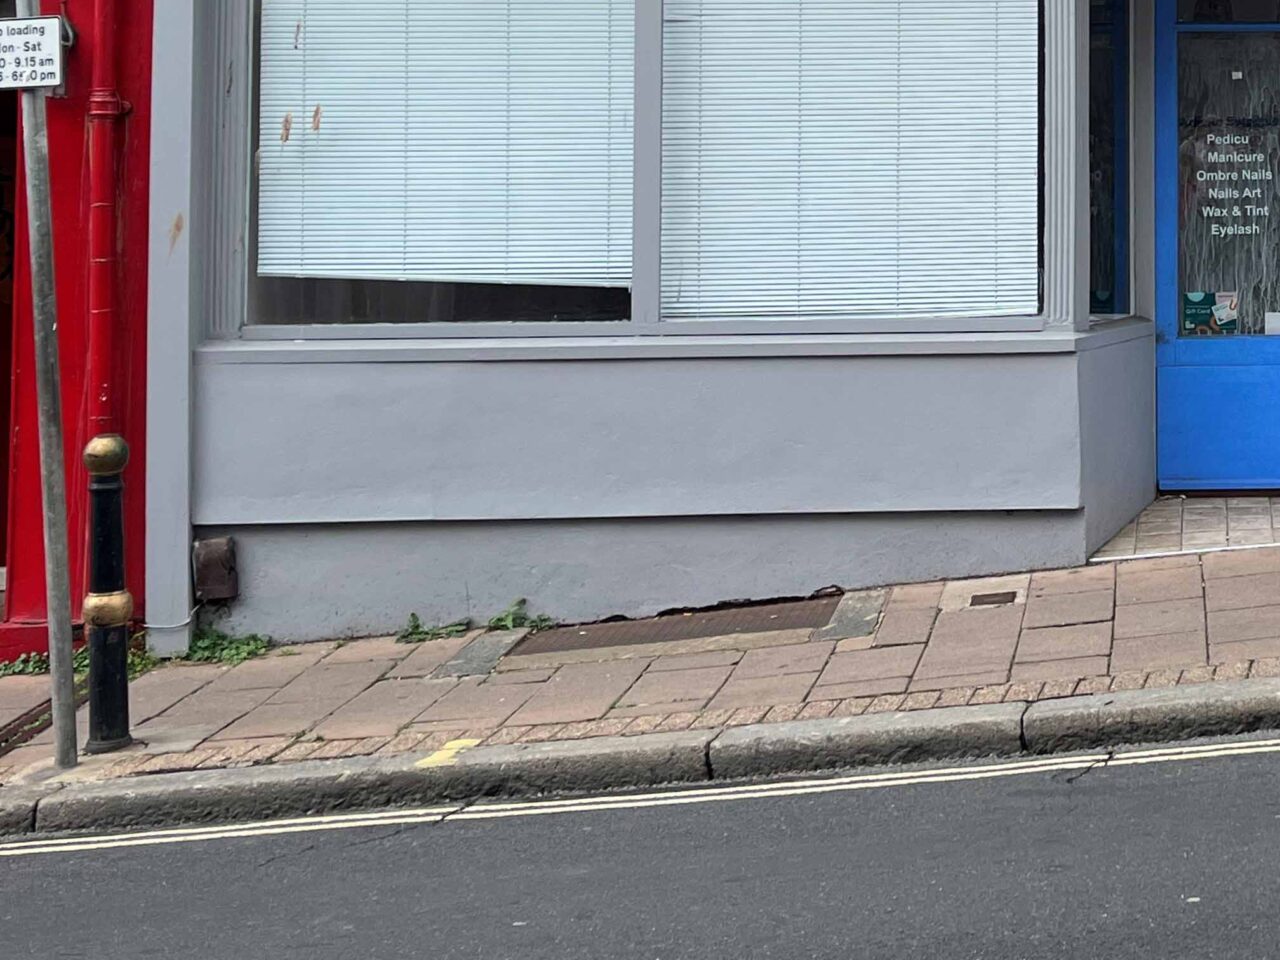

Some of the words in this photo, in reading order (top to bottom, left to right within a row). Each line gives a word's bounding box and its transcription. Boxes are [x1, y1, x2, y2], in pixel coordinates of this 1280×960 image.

[7, 25, 45, 36] loading
[0, 44, 14, 53] on
[23, 41, 42, 52] Sat
[14, 57, 36, 67] 9.15
[39, 58, 54, 66] am
[40, 71, 56, 81] pm
[1207, 152, 1265, 163] Manicure
[1196, 170, 1238, 181] Ombre
[1241, 169, 1273, 180] Nails
[1208, 188, 1240, 199] Nails
[1242, 187, 1262, 198] Art
[1201, 206, 1228, 217] Wax
[1232, 205, 1241, 216] &
[1245, 205, 1269, 216] Tint
[1211, 223, 1260, 238] Eyelash
